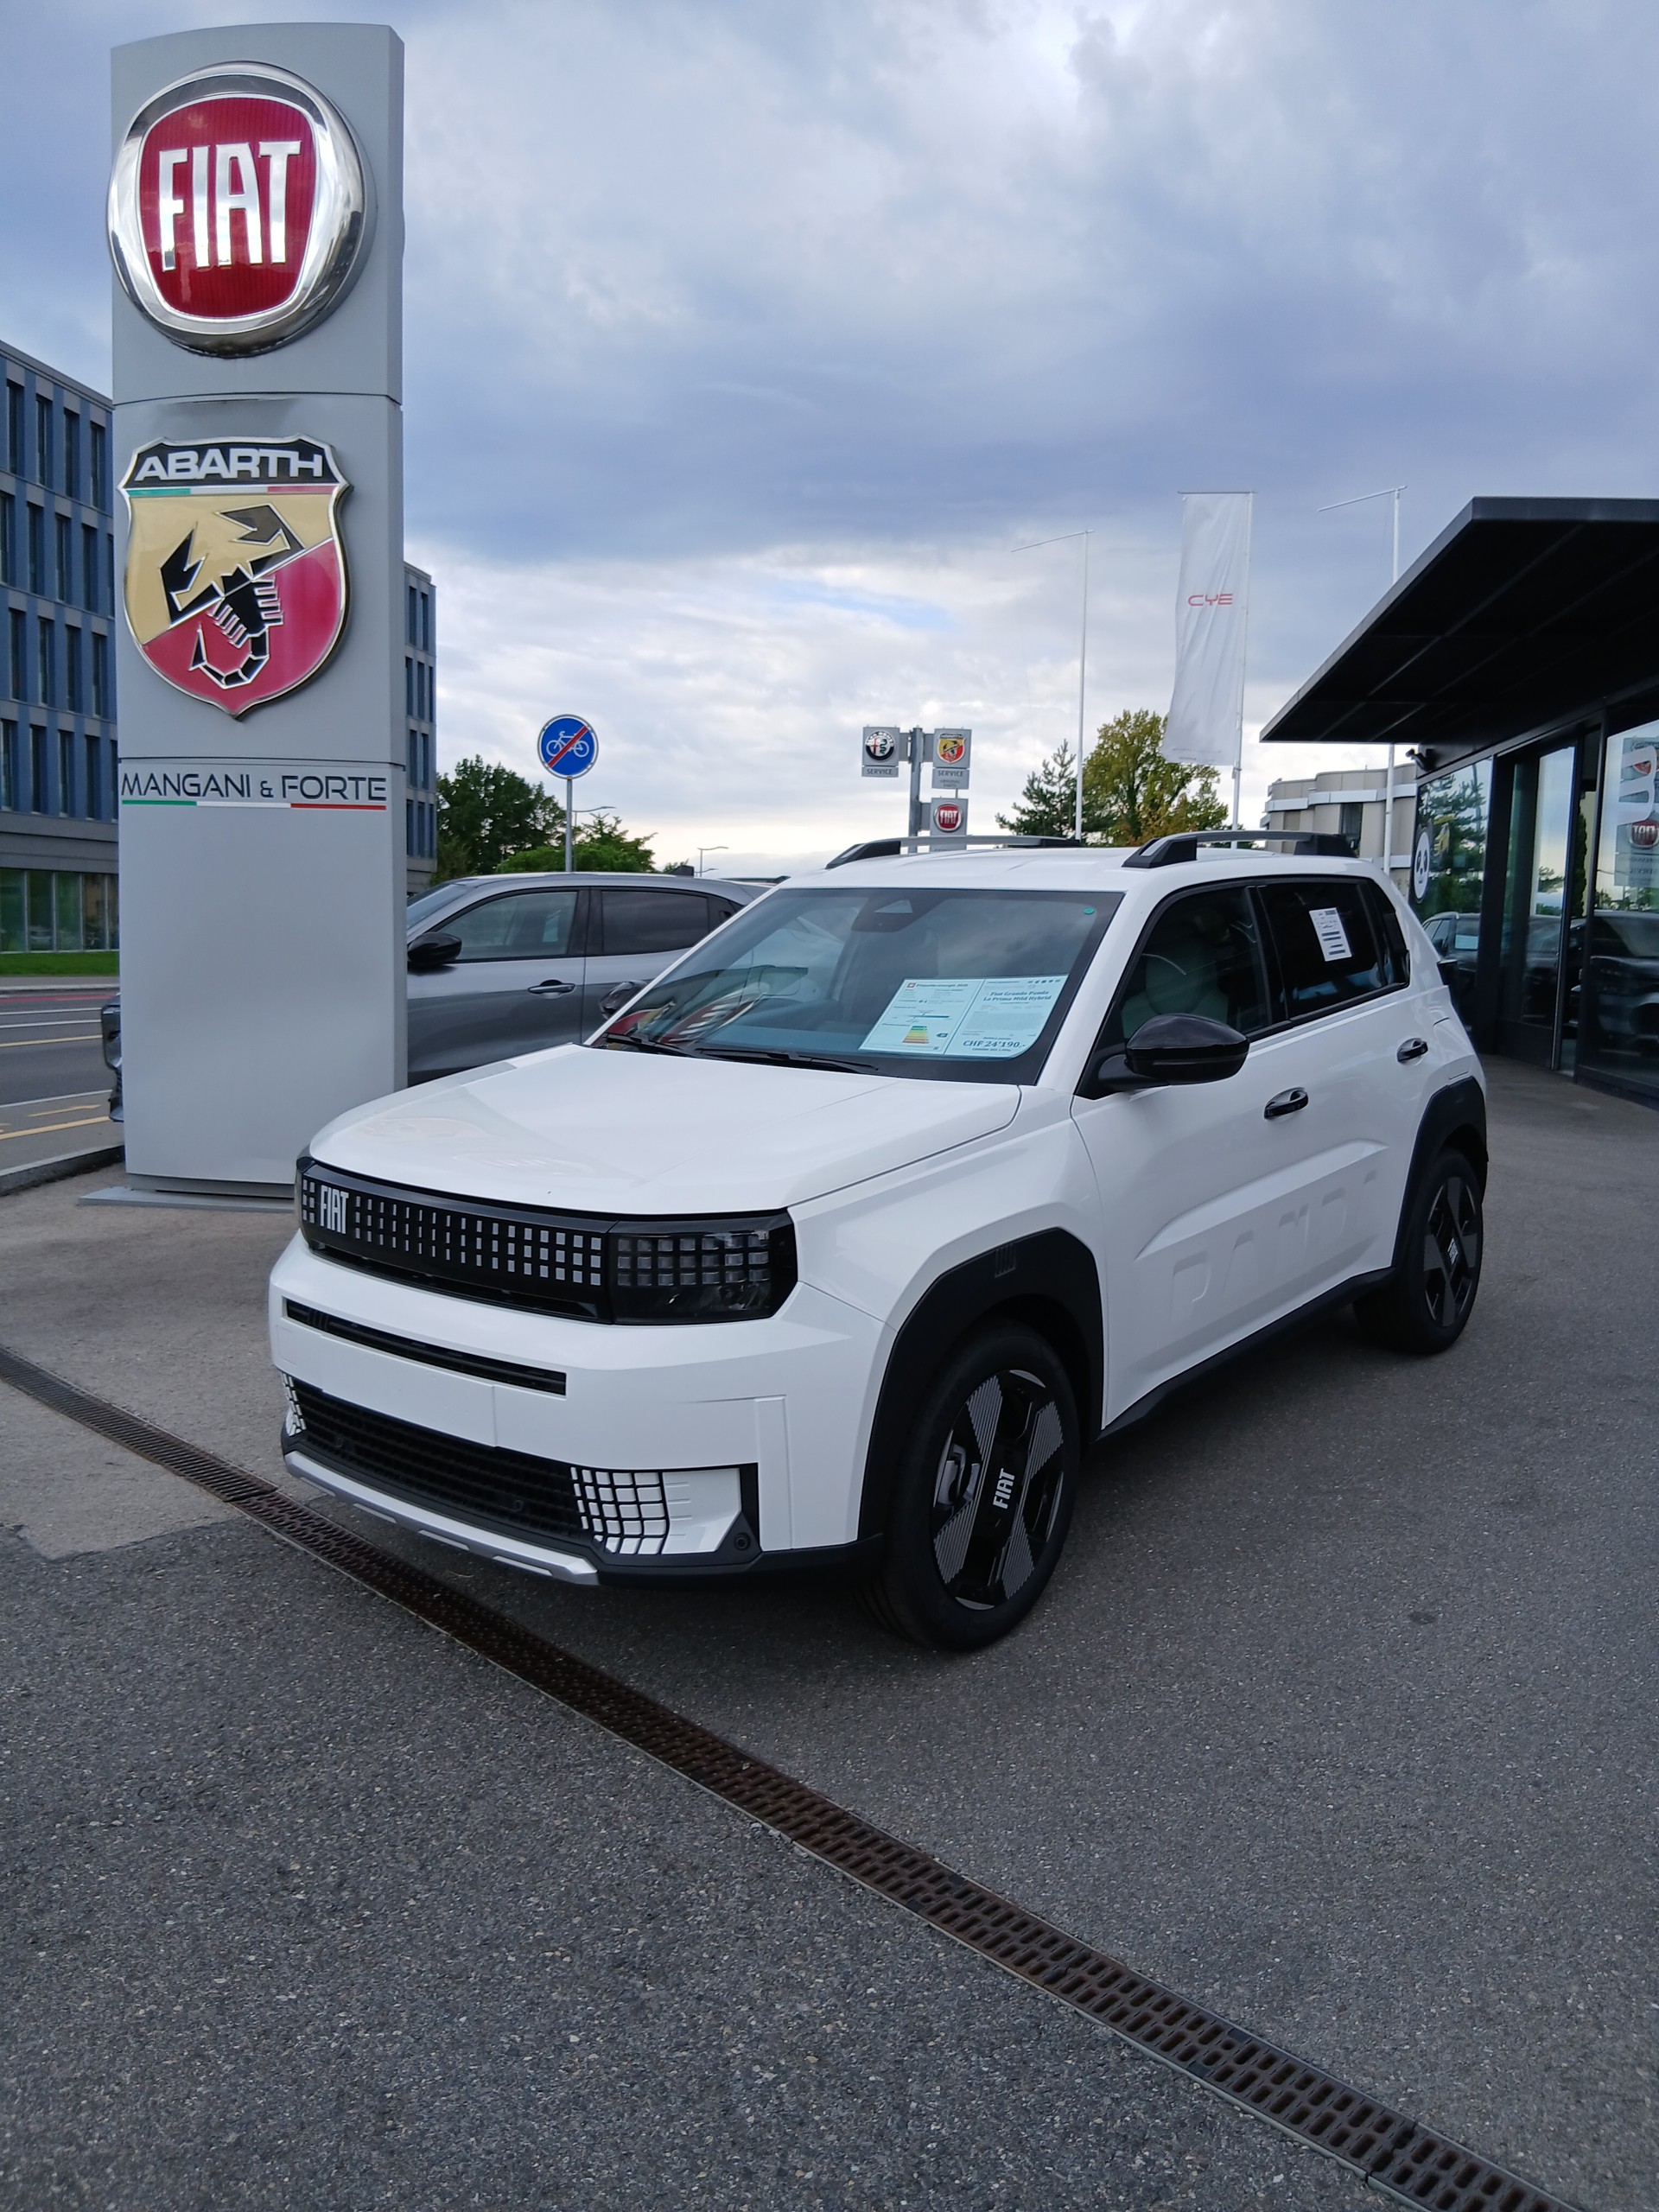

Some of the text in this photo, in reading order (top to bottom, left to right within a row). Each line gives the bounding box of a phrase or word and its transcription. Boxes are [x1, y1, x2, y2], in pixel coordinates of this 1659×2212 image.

[159, 141, 302, 271] FIAT
[134, 448, 323, 481] ABARTH
[1187, 593, 1233, 607] CYE
[121, 772, 387, 801] MANGANI & FORTE
[940, 810, 958, 824] FIAT
[320, 1185, 349, 1235] FIAT
[993, 1468, 1015, 1510] FIAT
